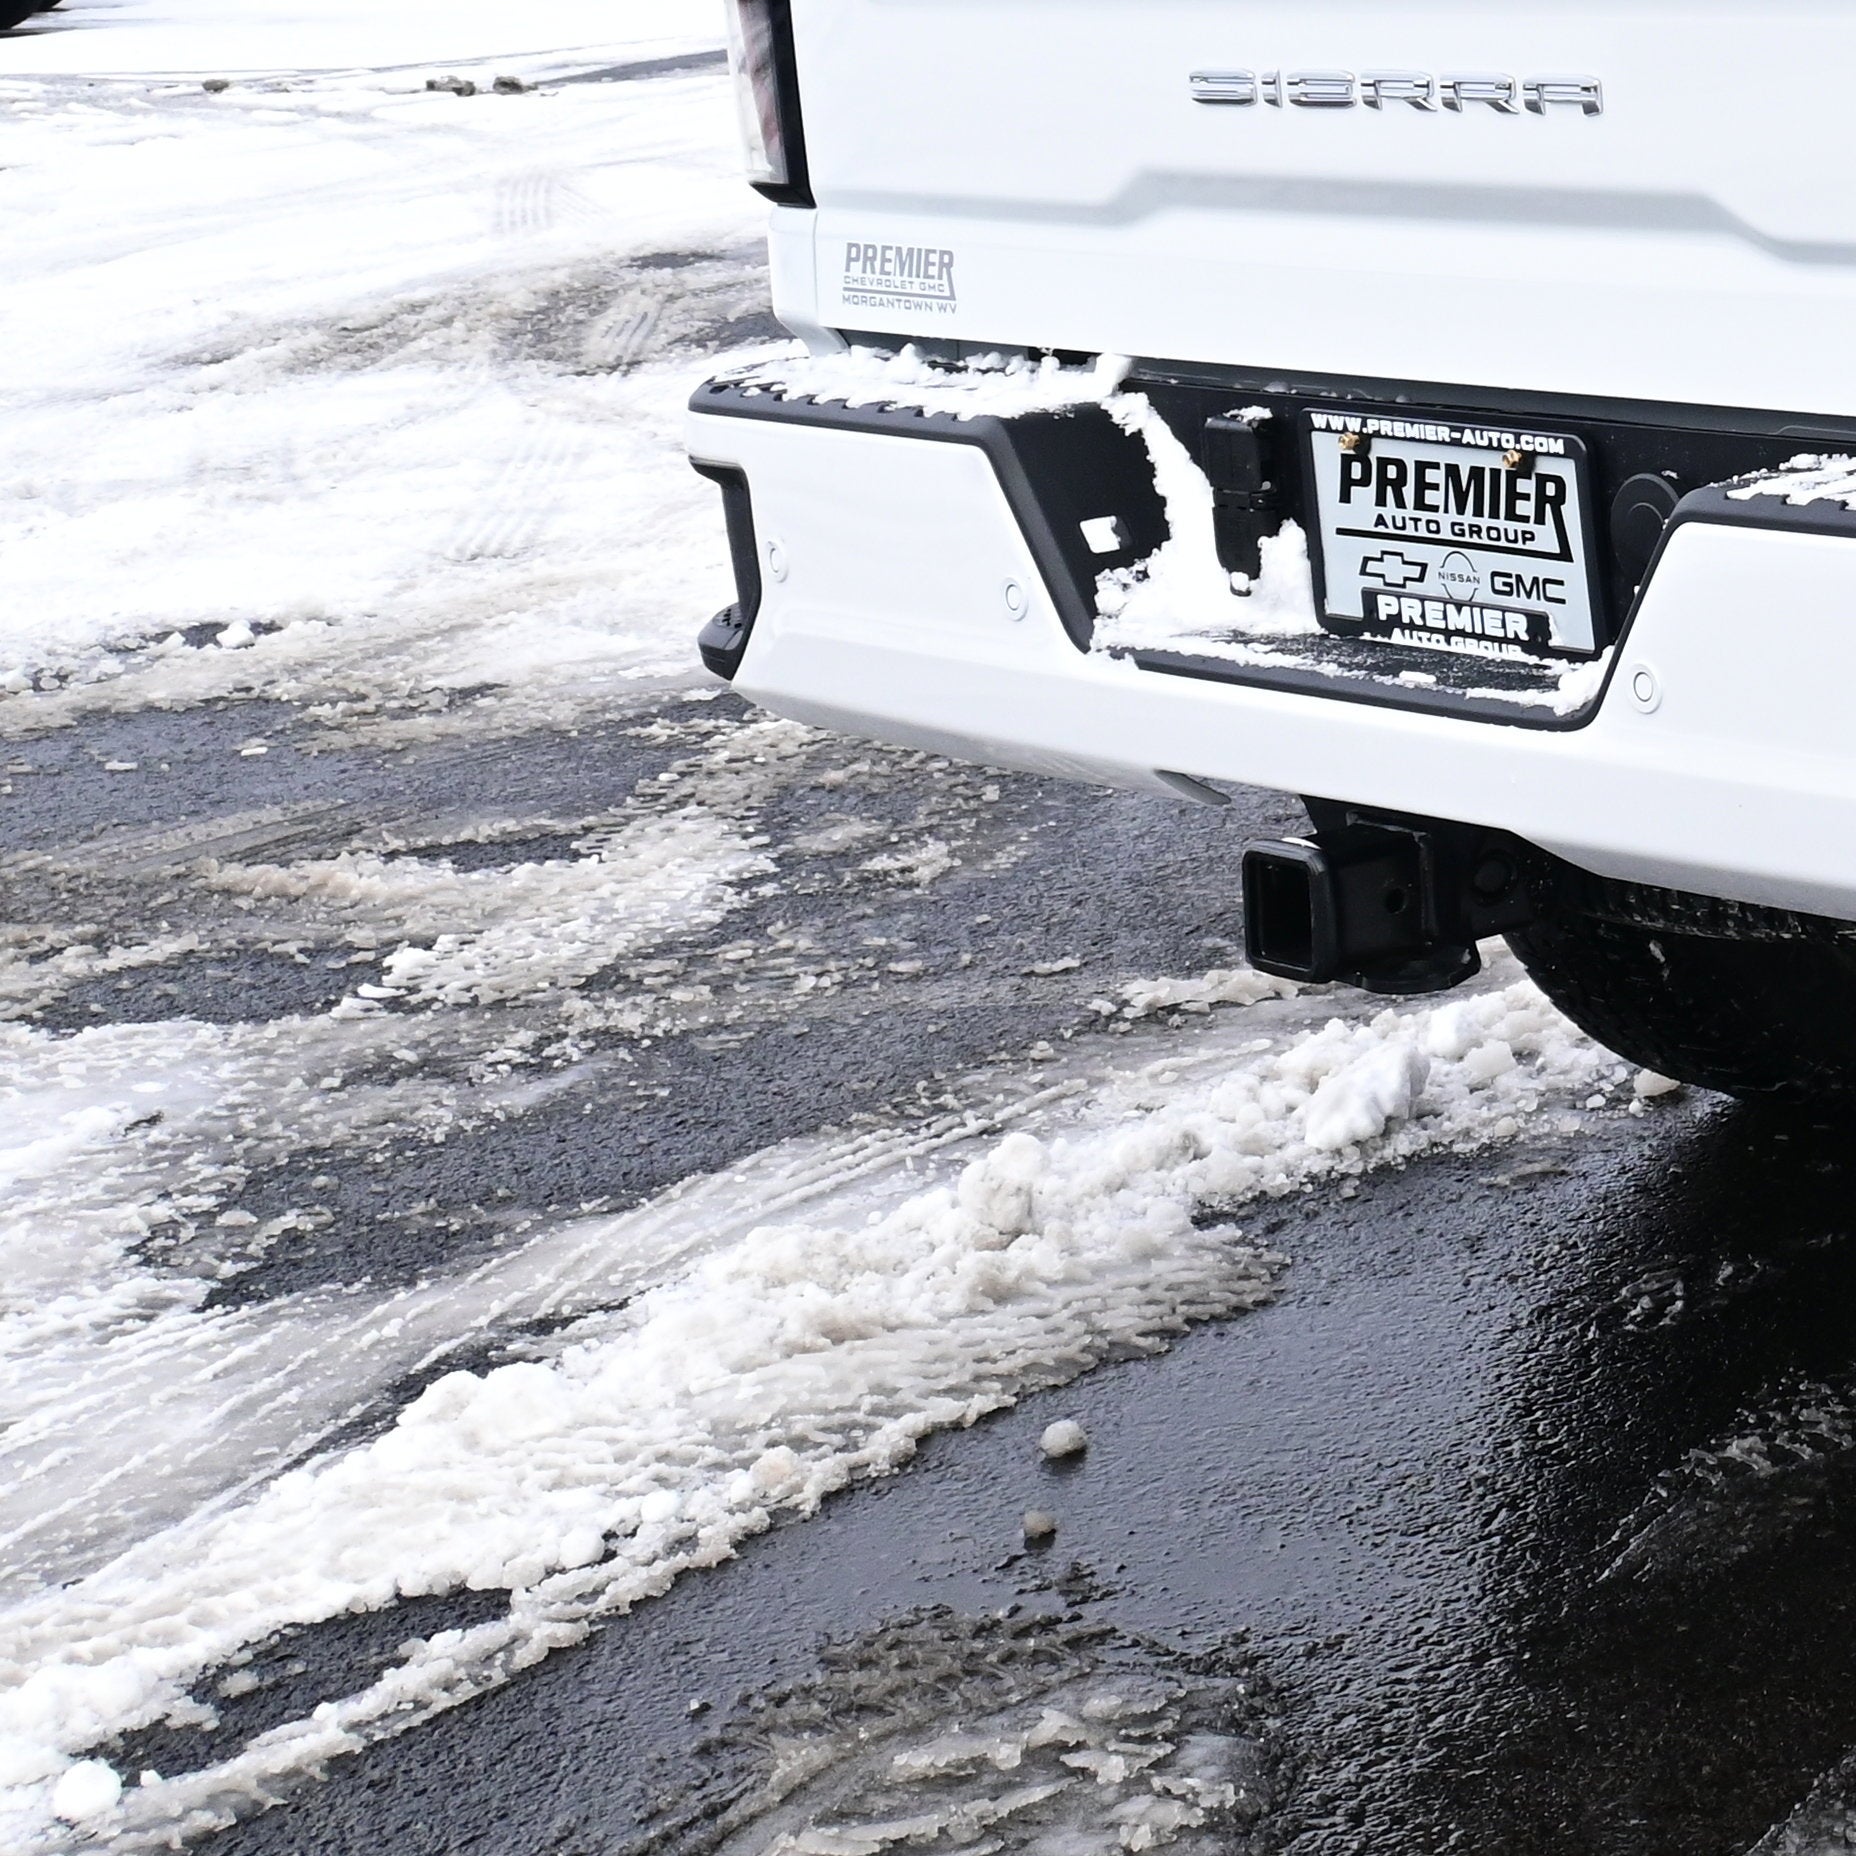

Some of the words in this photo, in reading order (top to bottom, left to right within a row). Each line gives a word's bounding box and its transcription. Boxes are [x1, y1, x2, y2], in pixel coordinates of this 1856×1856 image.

[1188, 66, 1605, 117] SIERRA
[844, 241, 955, 281] PREMIER
[843, 275, 915, 290] CHEVROLET
[918, 281, 945, 293] GMC
[842, 293, 934, 313] MORGANTOWN
[936, 302, 957, 314] WV
[1310, 412, 1565, 455] WWW.PREMIER-AUTO.COM
[1338, 452, 1568, 528] PREMIER
[1374, 512, 1442, 536] AUTO
[1450, 520, 1536, 546] GROUP
[1437, 571, 1481, 586] NISSAN
[1489, 571, 1567, 605] GMC
[1376, 594, 1530, 641] PREMIER
